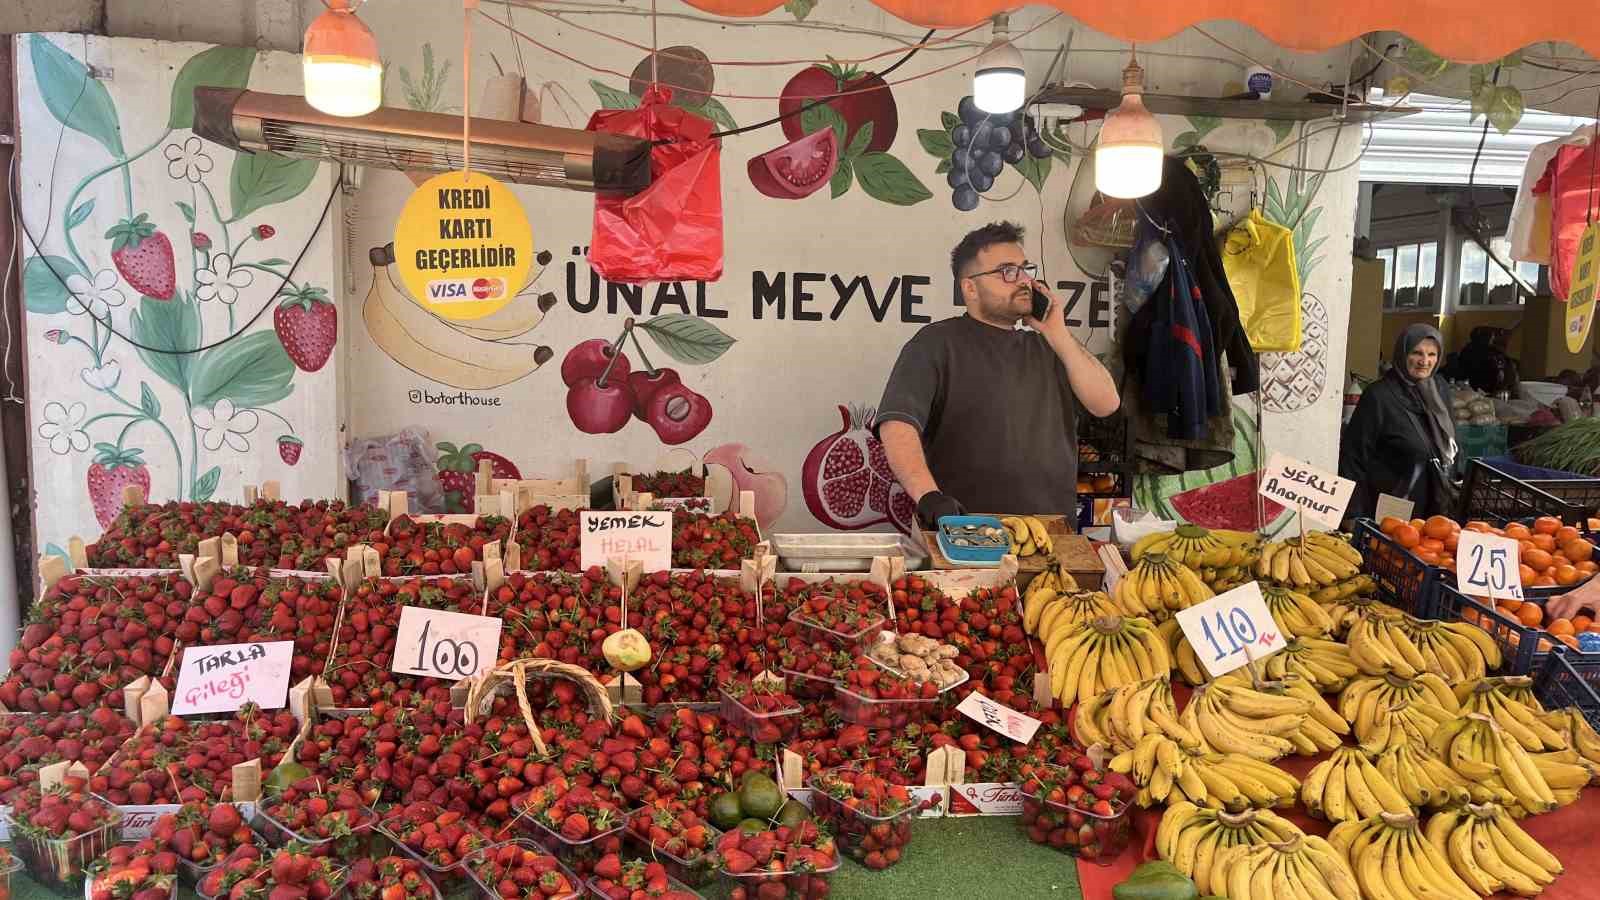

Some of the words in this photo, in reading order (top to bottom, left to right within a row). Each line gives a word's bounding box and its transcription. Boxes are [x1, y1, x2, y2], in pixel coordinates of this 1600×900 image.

[438, 185, 491, 209] KREDİ
[439, 218, 492, 239] KARTI
[415, 244, 516, 273] GEÇERLİDİR
[430, 283, 467, 297] VISA
[566, 246, 728, 318] ÜNAL
[752, 271, 932, 323] MEYVE
[1467, 544, 1507, 590] 25
[409, 619, 479, 676] 100
[1200, 607, 1257, 661] 110
[192, 644, 266, 676] TARLA
